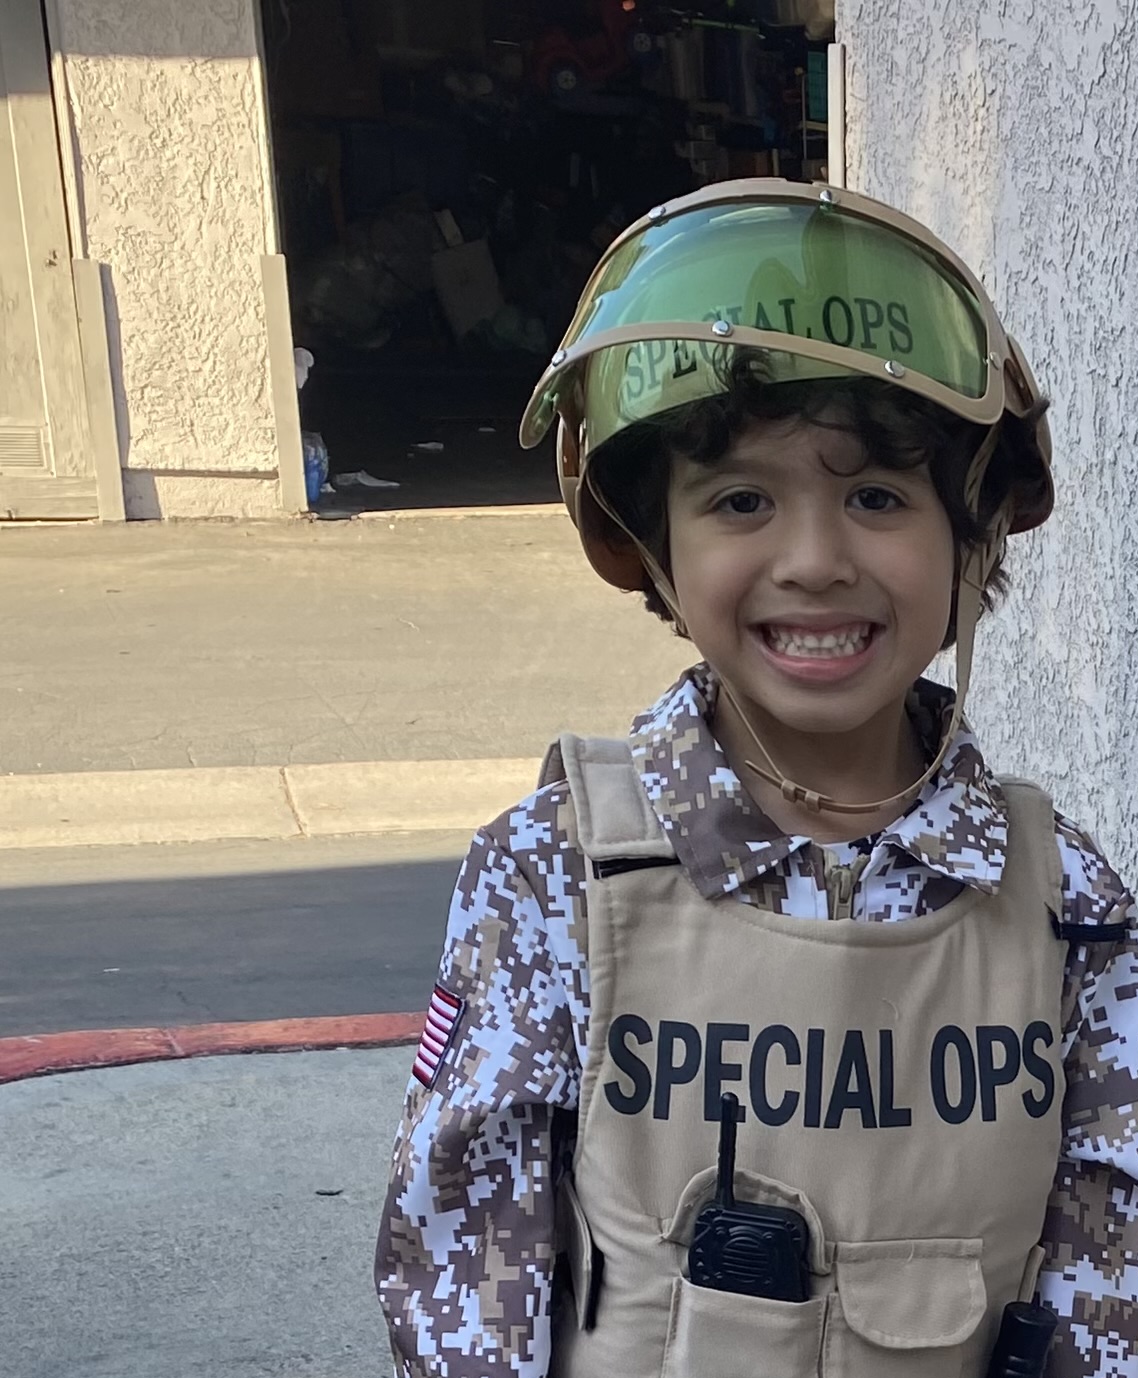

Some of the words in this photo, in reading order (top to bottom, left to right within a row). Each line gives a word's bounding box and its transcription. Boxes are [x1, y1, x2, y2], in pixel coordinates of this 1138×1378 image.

[822, 295, 914, 355] OPS
[603, 1013, 912, 1129] SPECIAL
[930, 1020, 1055, 1125] OPS
